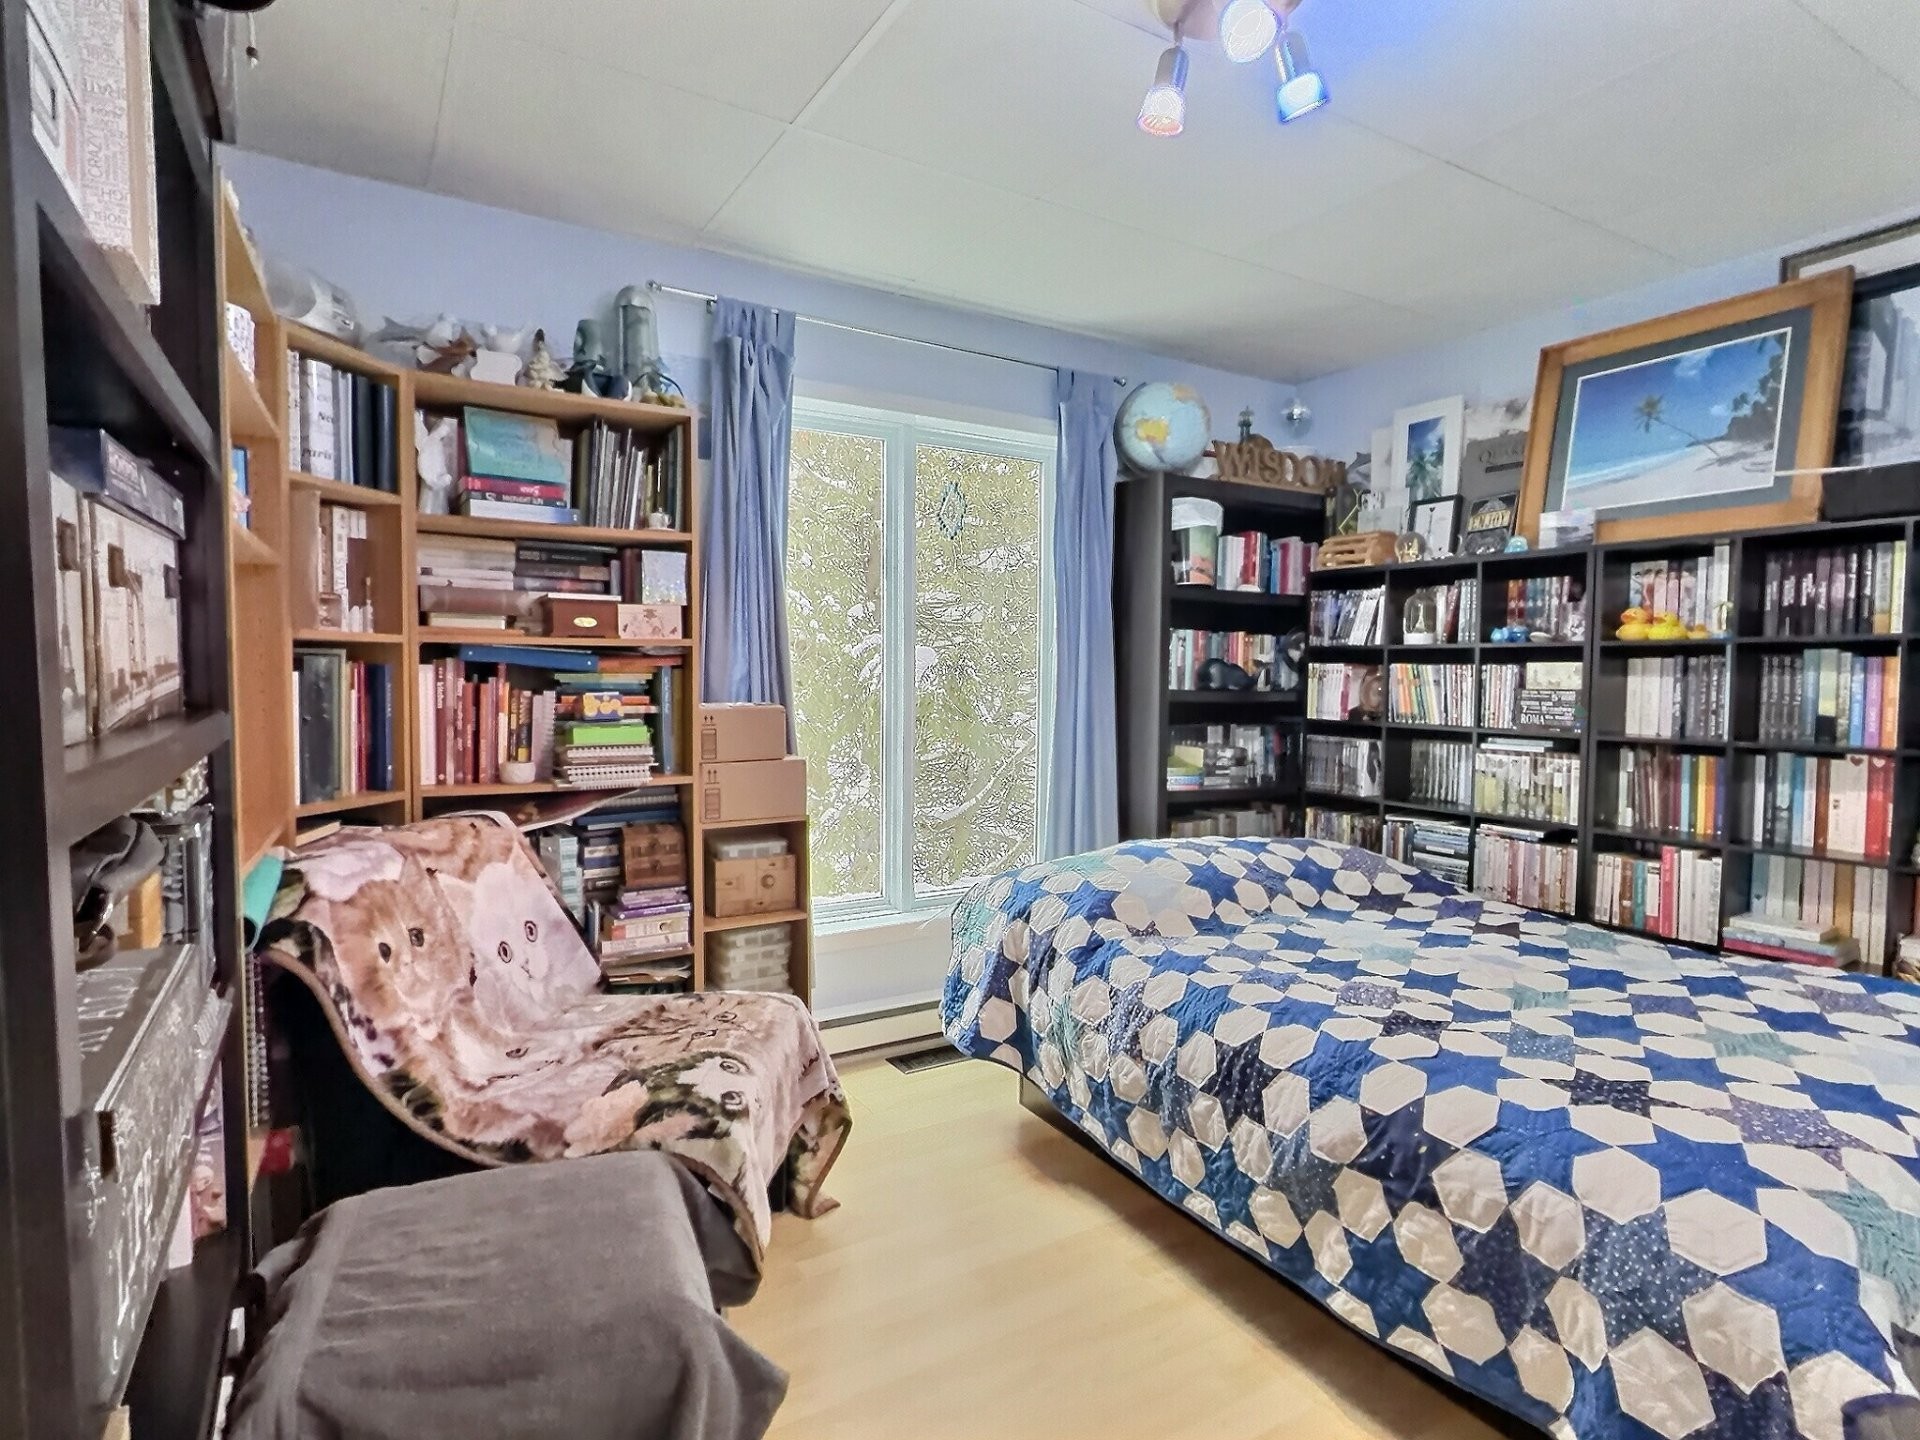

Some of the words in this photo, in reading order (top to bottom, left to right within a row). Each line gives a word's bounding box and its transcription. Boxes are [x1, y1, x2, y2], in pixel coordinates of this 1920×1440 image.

[1211, 440, 1346, 491] WISDOM
[335, 558, 346, 592] ATLAS
[1520, 713, 1545, 725] ROMA
